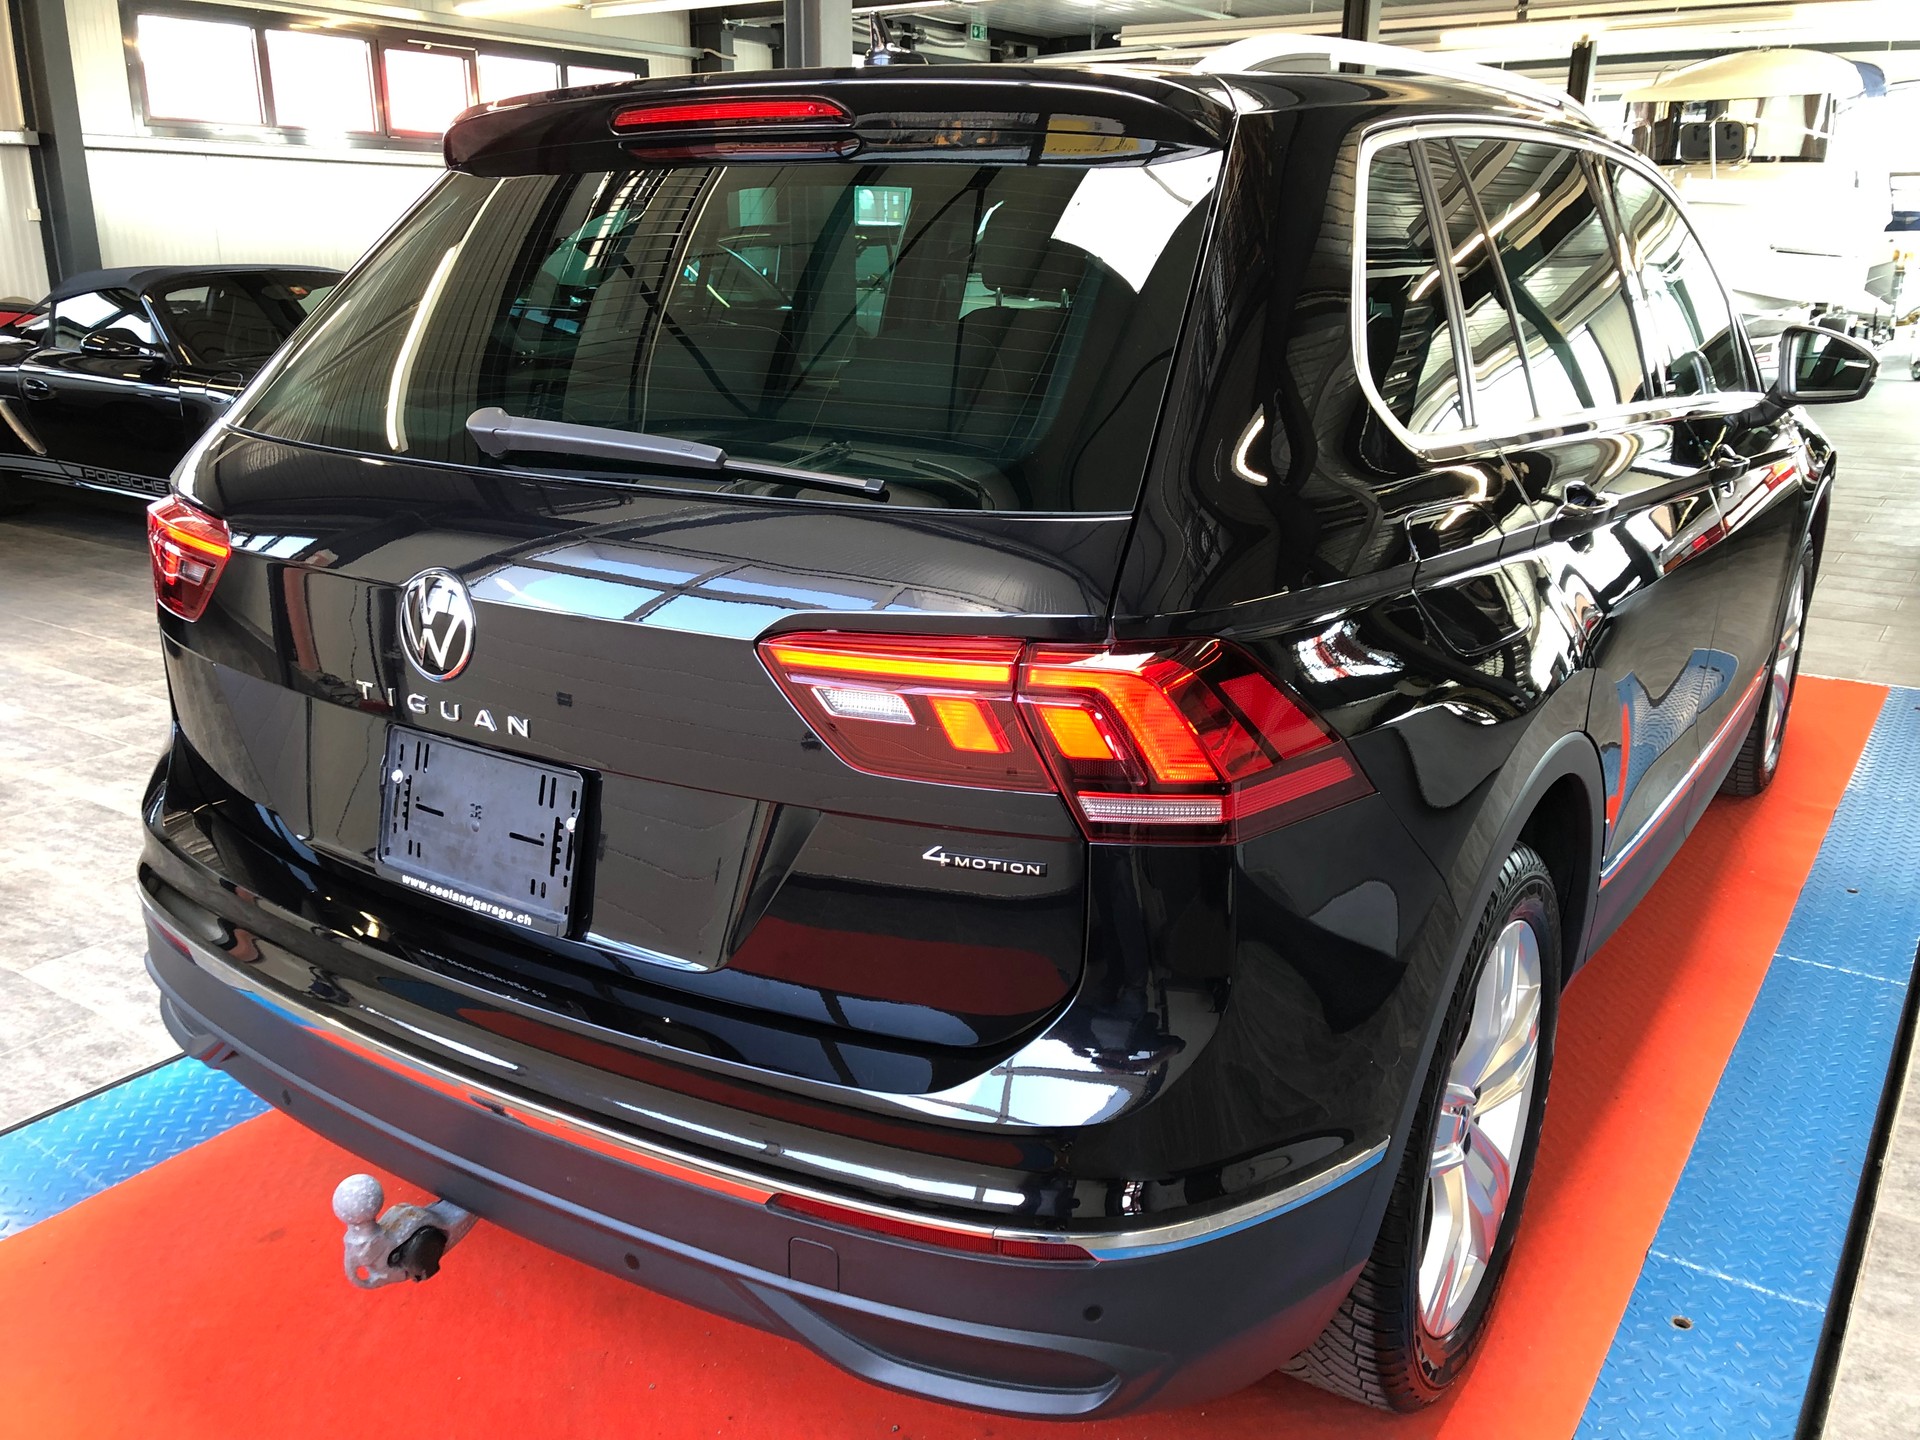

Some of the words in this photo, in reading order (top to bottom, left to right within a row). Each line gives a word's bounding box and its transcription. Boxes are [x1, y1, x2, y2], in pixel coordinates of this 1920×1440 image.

[84, 468, 168, 493] PORSCHE
[402, 570, 474, 680] VW
[356, 680, 532, 738] TIGUAN
[402, 874, 532, 926] www.seelandgarage.ch
